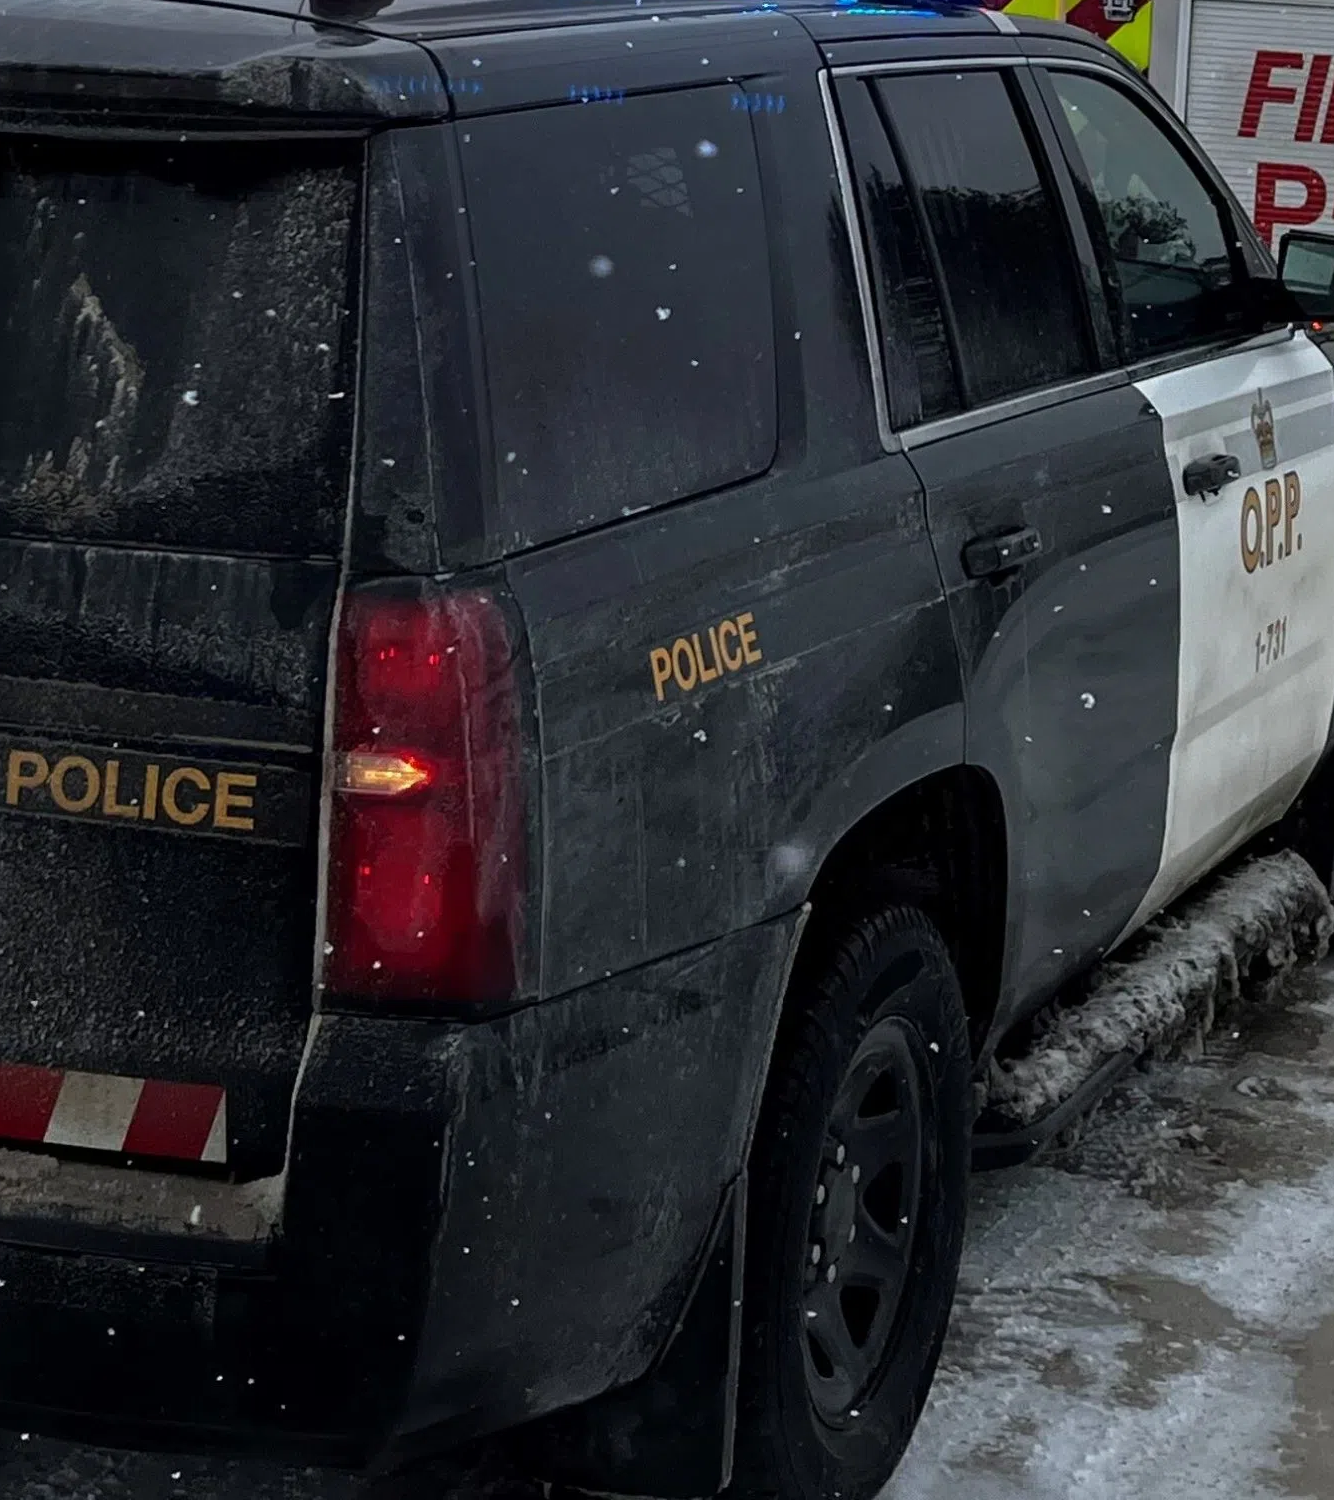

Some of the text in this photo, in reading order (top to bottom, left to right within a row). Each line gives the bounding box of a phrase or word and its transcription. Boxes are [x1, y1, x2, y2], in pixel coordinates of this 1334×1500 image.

[1240, 470, 1303, 574] O.P.P.
[650, 611, 763, 702] POLICE
[5, 749, 258, 830] POLICE
